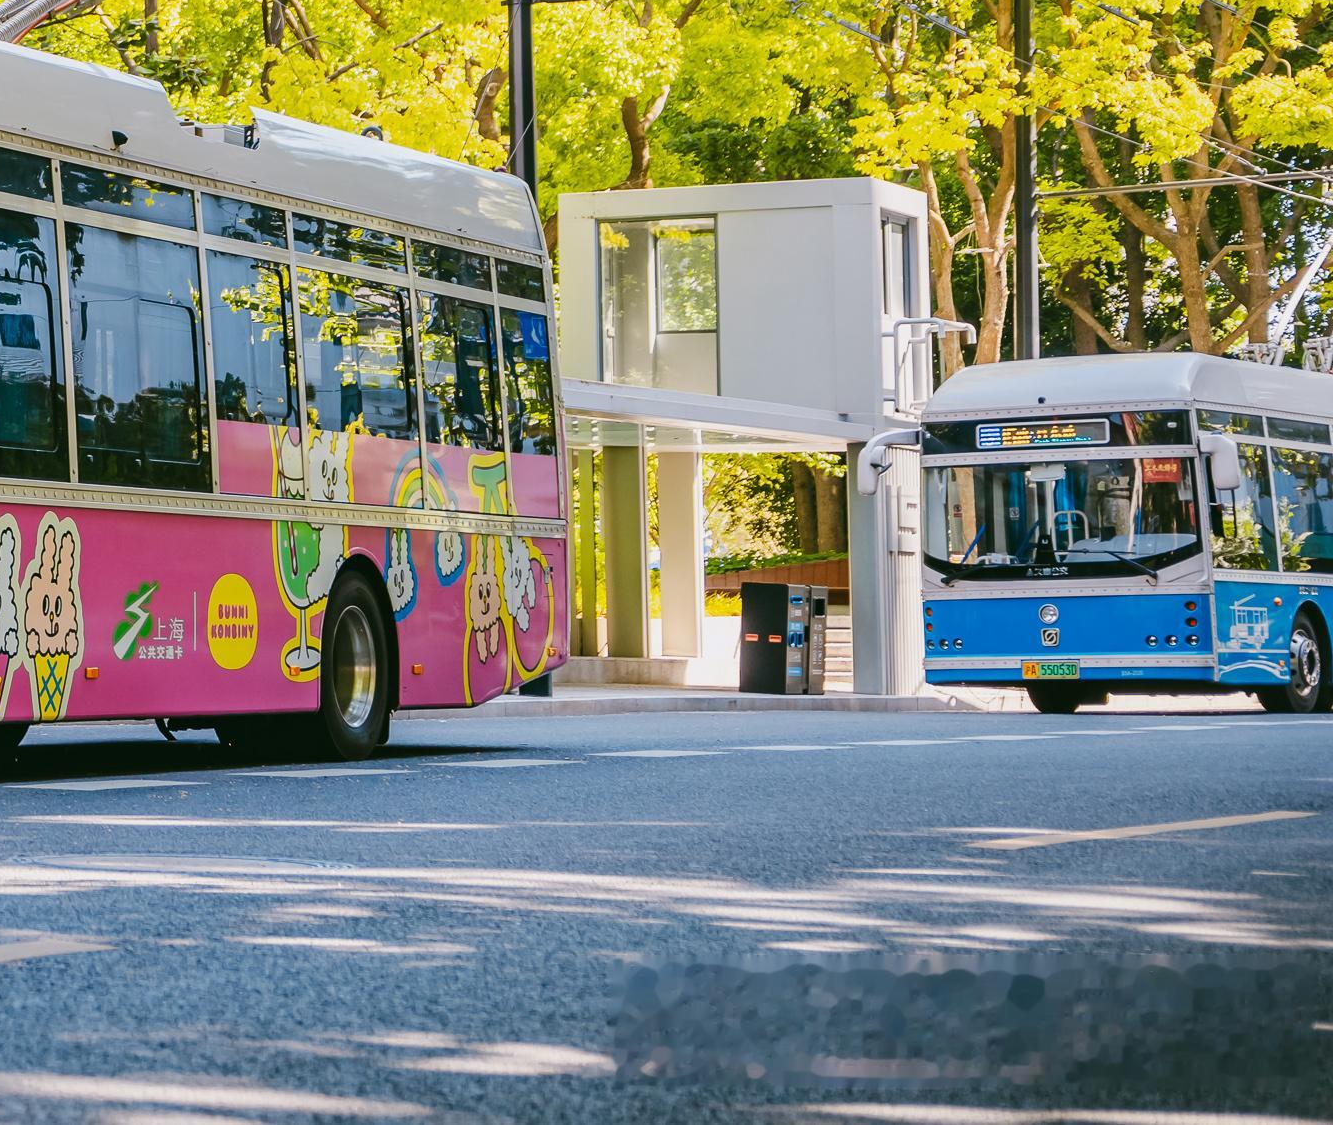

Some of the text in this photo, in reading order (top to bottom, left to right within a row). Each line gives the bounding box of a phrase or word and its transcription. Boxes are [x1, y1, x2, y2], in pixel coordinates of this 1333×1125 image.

[218, 603, 249, 620] BUNNI
[152, 616, 185, 642] 上海
[211, 623, 255, 640] KONBINY
[138, 645, 184, 660] 公共交通卡
